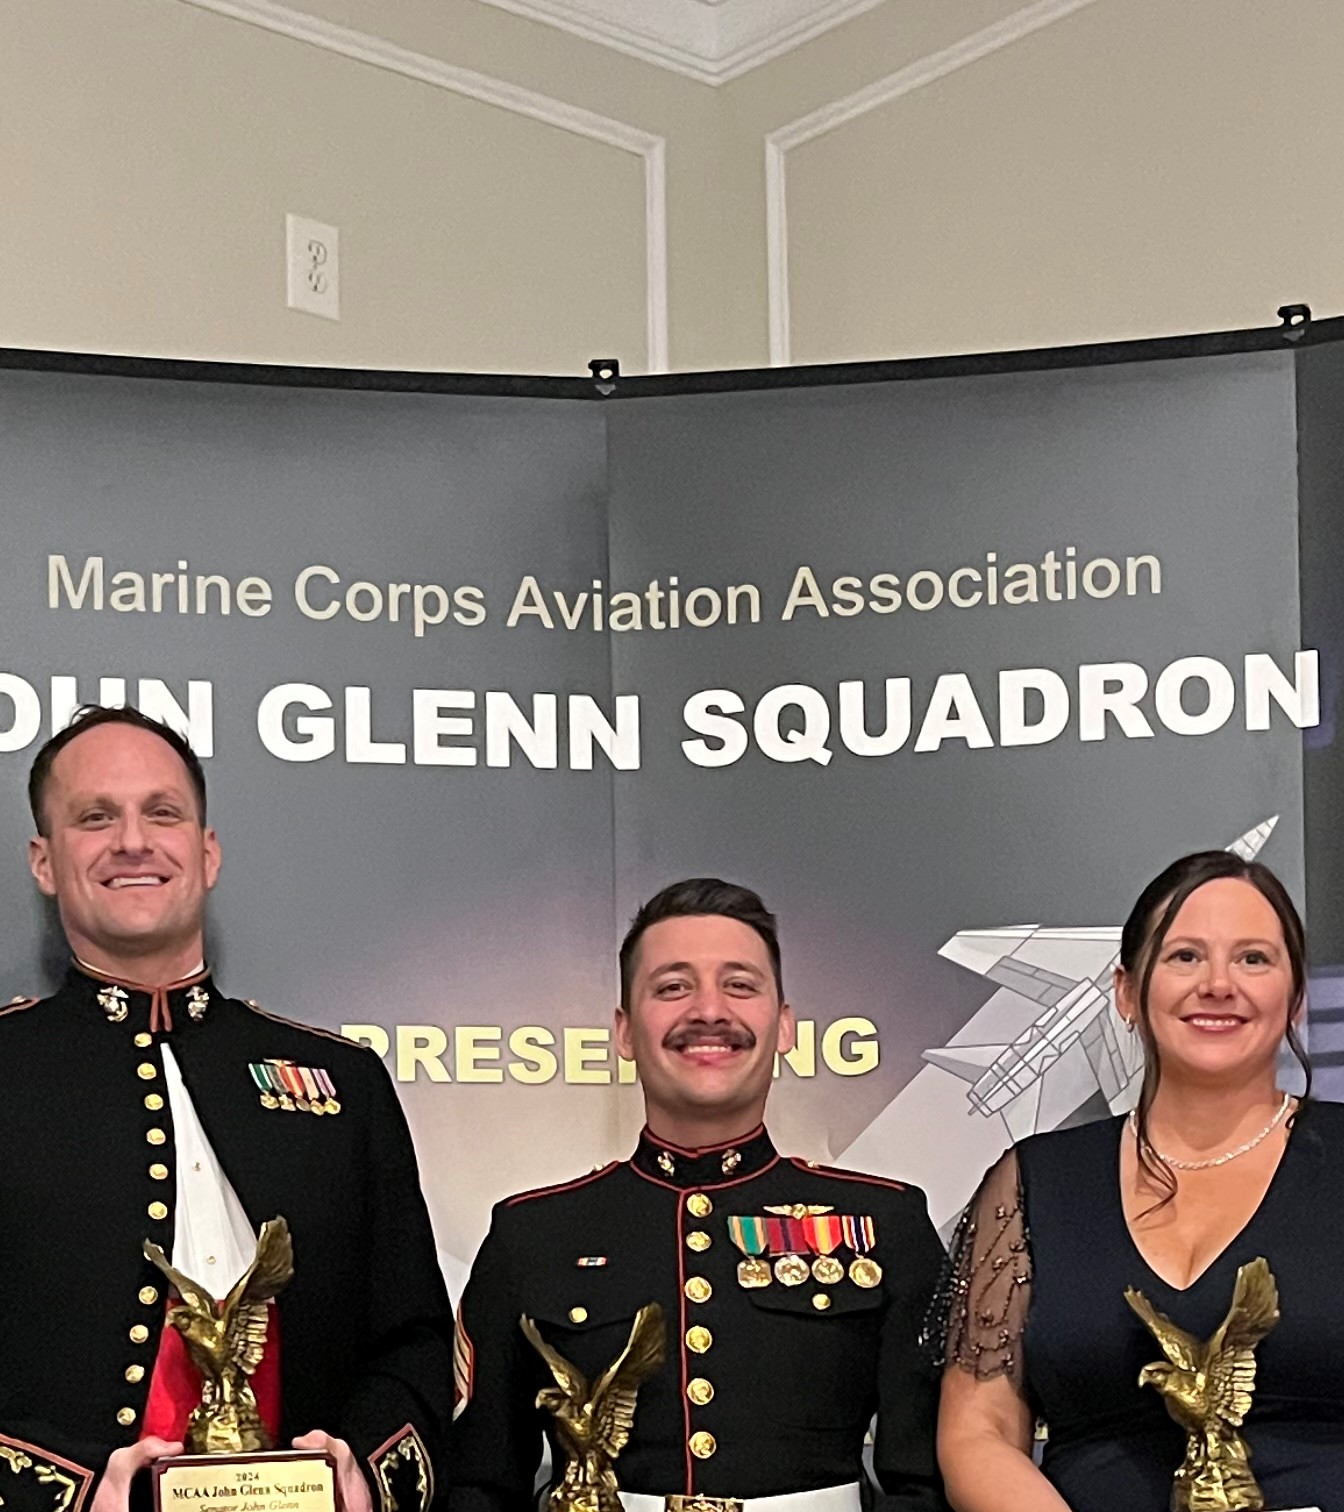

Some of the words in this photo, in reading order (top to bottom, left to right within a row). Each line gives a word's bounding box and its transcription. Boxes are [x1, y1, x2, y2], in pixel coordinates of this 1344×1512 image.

[47, 554, 273, 618] Marine
[293, 563, 487, 637] Corps
[506, 574, 761, 632] Aviation
[781, 547, 1163, 621] Association
[256, 682, 641, 771] GLENN
[680, 648, 1321, 770] SQUADRON
[236, 1472, 260, 1482] 2024
[172, 1487, 210, 1500] MCAA
[212, 1485, 237, 1498] John
[239, 1484, 271, 1496] Glenn
[274, 1482, 324, 1497] Squadron
[240, 1502, 266, 1512] John
[269, 1500, 299, 1510] Glenn
